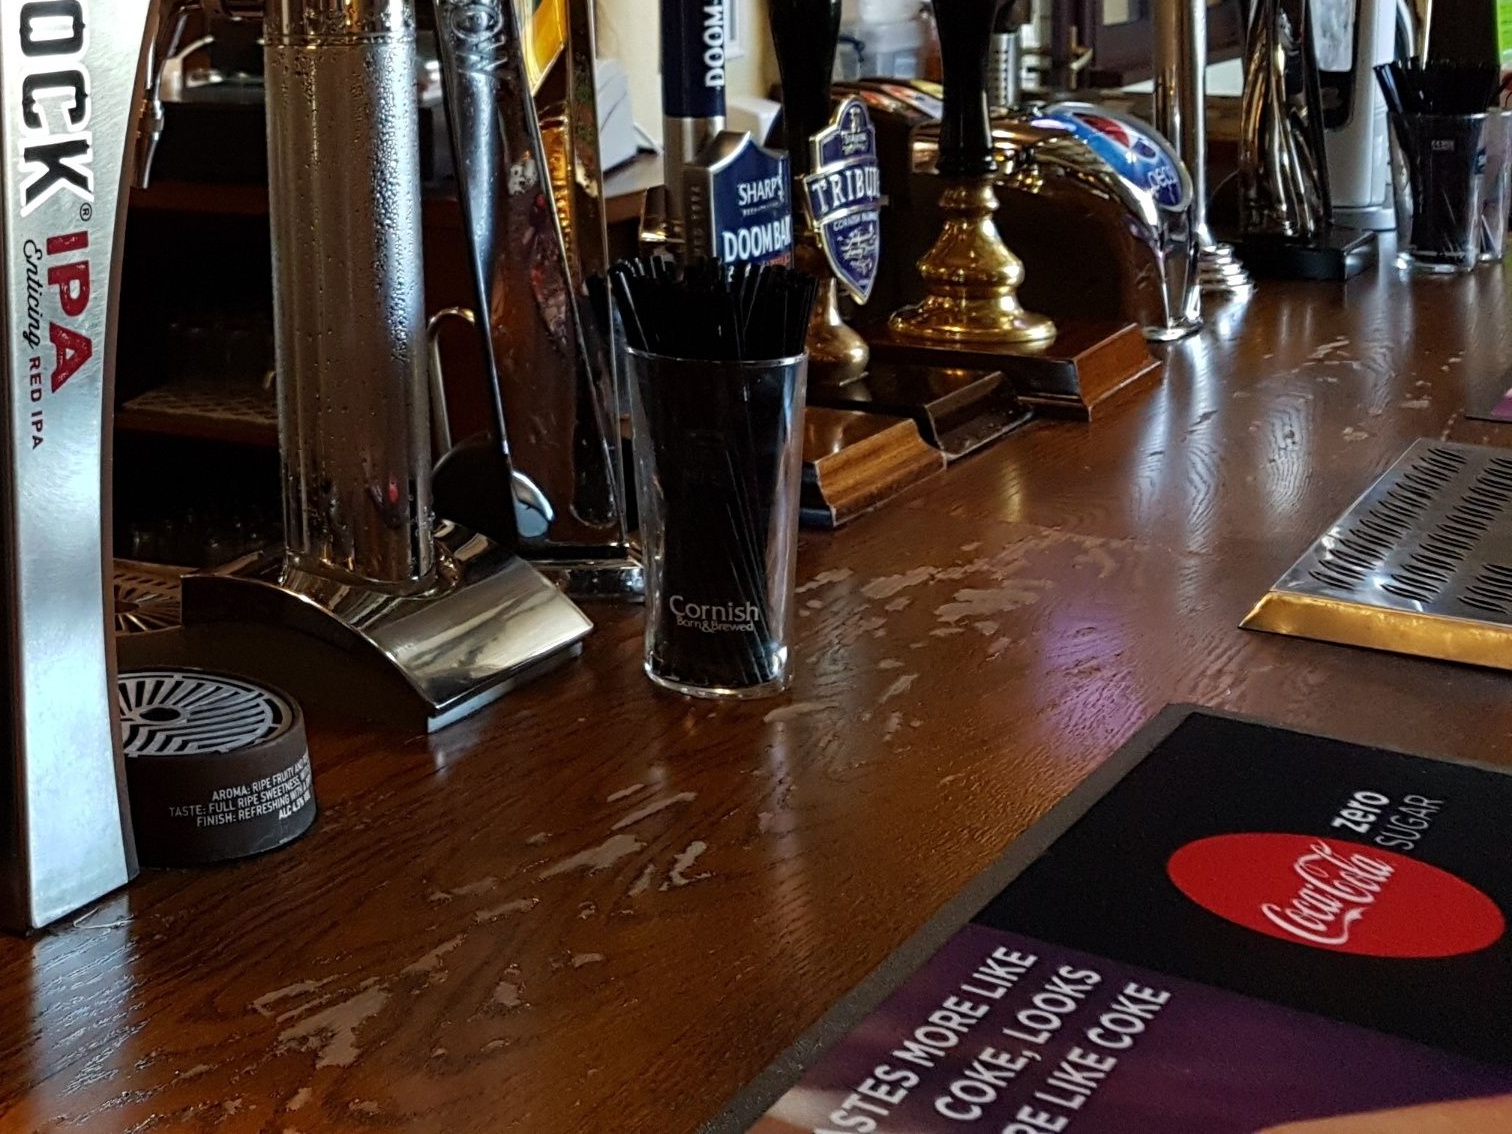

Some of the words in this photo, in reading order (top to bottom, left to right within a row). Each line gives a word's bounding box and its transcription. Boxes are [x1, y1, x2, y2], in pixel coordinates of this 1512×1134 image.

[22, 238, 44, 350] Enticing
[45, 230, 93, 394] IPA
[28, 355, 43, 403] RED
[30, 410, 44, 450] IPA
[669, 595, 760, 622] Cornish
[169, 804, 207, 818] TASTE:
[208, 800, 237, 814] FULL
[237, 795, 259, 810] RIPE
[260, 776, 302, 803] SWEETNESS
[196, 813, 237, 827] FINISH:
[238, 795, 290, 822] REFRESHING
[211, 785, 251, 802] AROMA:
[252, 777, 271, 793] RIPE
[278, 805, 292, 820] ALC
[1330, 789, 1390, 834] zero
[1375, 793, 1445, 851] SUGAR
[813, 1064, 921, 1134] STES
[892, 995, 990, 1068] MORE
[960, 945, 1039, 1012] LIKE
[933, 1045, 1043, 1122] COKE,
[1002, 964, 1103, 1046] LOOKS
[1034, 1045, 1118, 1112] LIKE
[1086, 981, 1173, 1050] COKE
